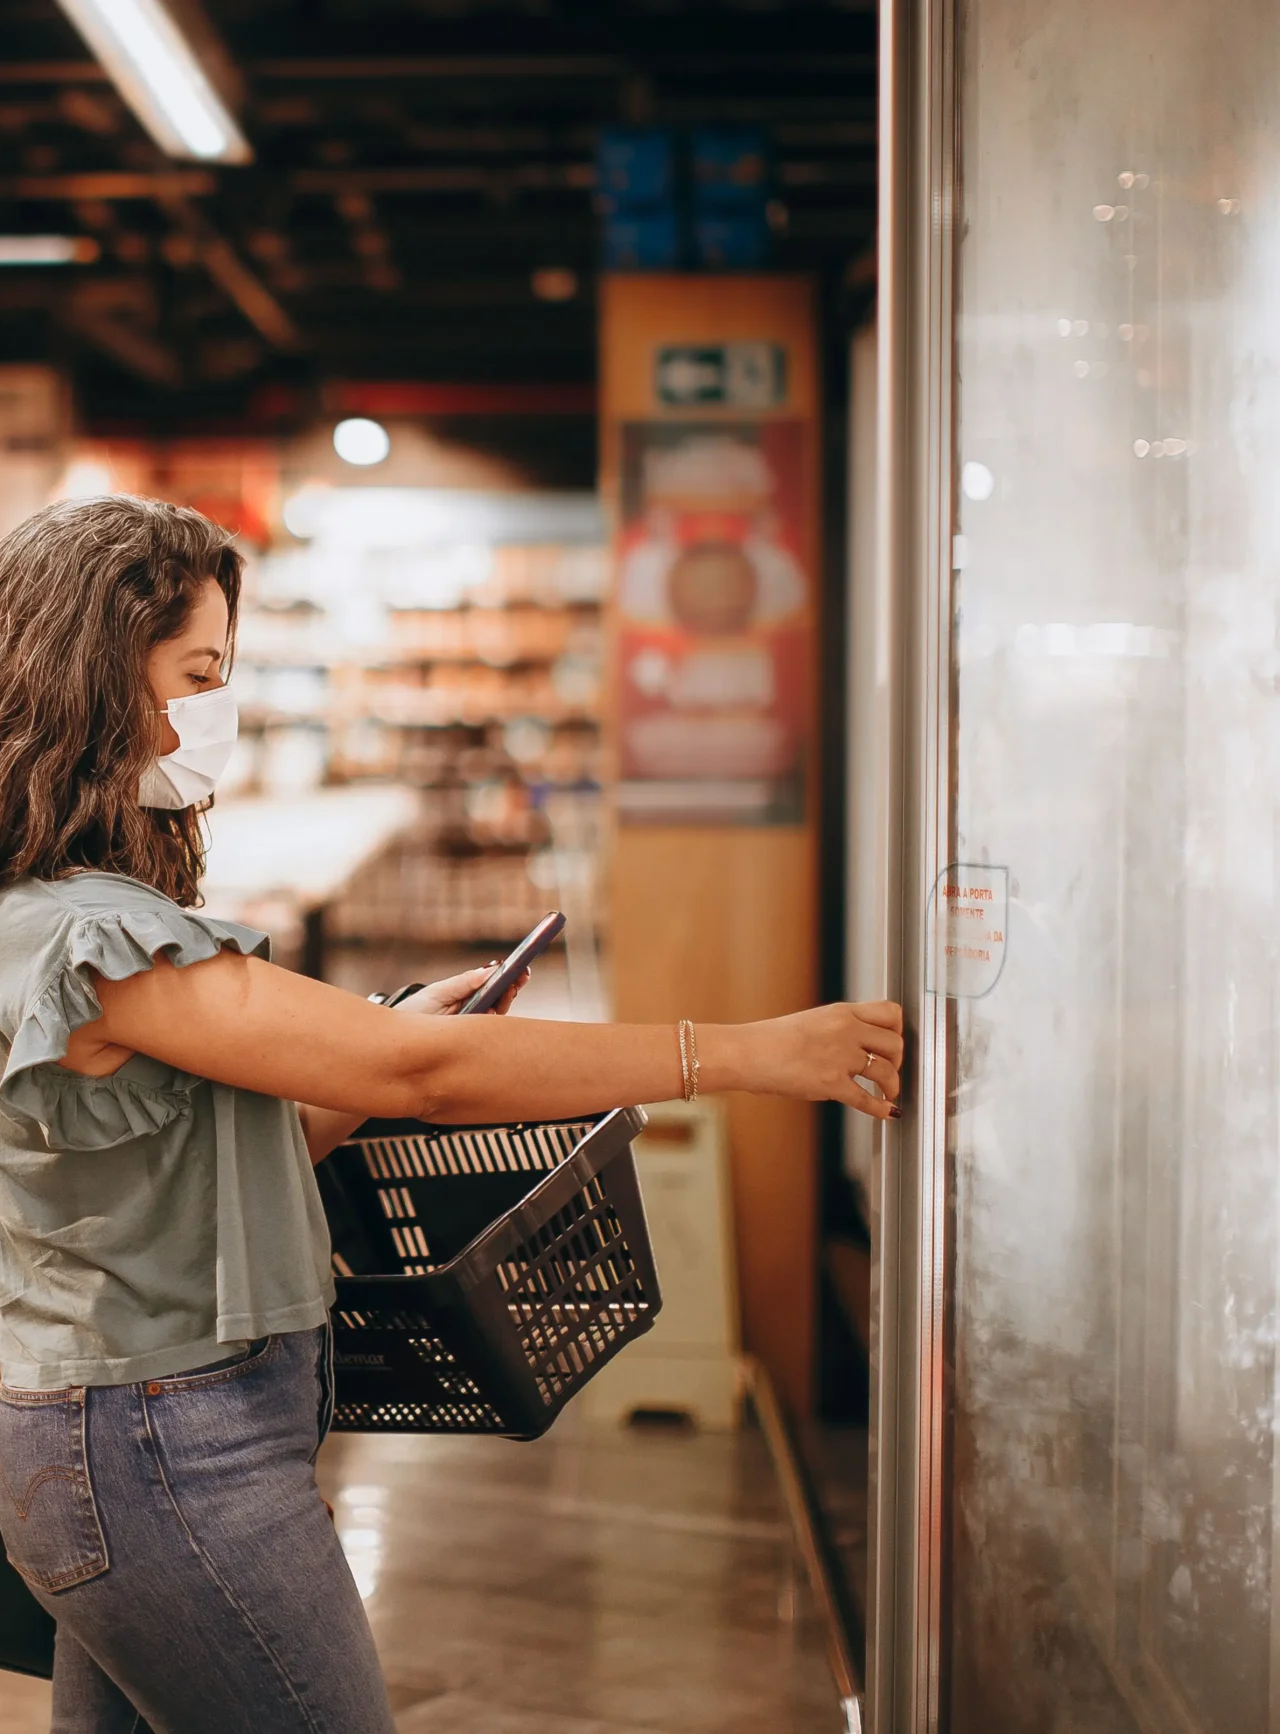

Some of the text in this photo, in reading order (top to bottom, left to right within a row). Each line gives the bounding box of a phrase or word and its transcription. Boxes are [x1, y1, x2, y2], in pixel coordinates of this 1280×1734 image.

[942, 885, 961, 898] ABRA
[969, 887, 993, 901] PORTA
[950, 905, 984, 920] SOMENTE
